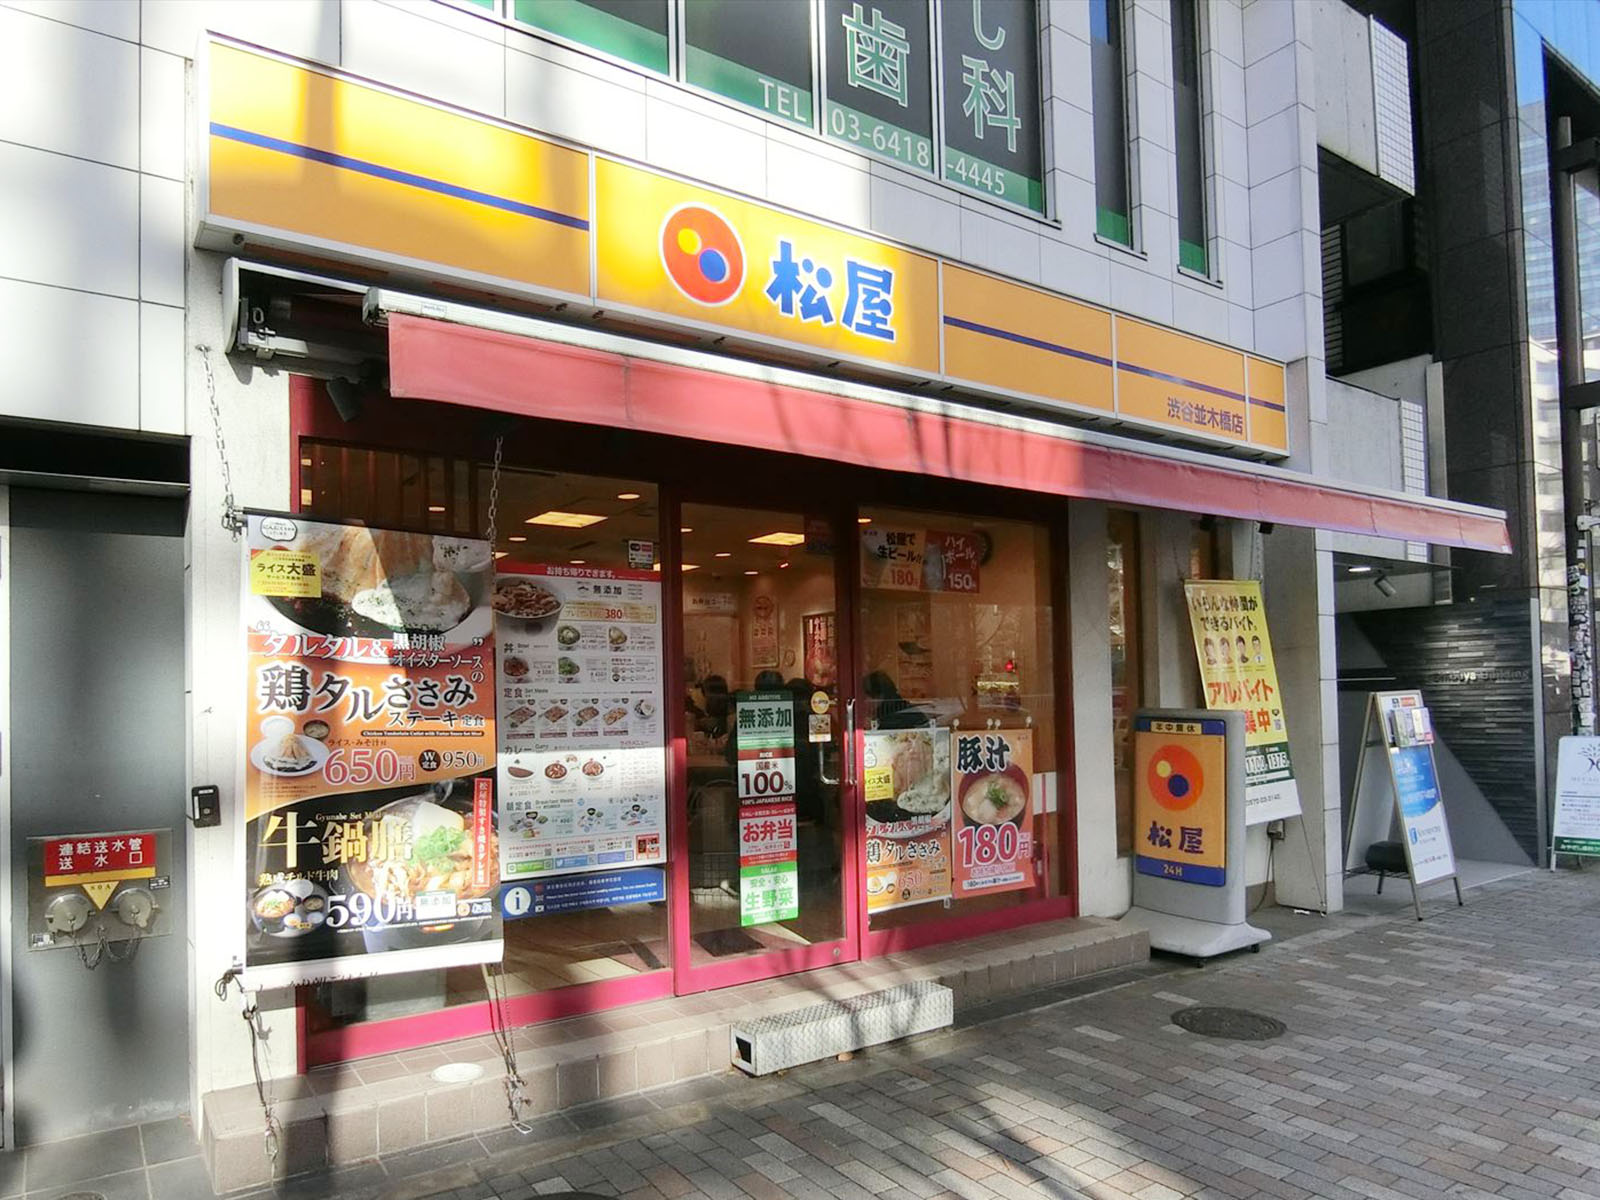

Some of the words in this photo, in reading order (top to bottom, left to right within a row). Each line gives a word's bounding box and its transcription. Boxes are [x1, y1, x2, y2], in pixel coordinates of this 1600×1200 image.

[758, 78, 807, 122] TEL
[765, 239, 895, 342] 松屋
[1167, 396, 1243, 435] 渋谷並木橋店
[257, 563, 316, 577] ライス大盛
[392, 632, 446, 651] 黒胡椒
[260, 664, 475, 722] 鶏タルささみ
[504, 687, 523, 698] 定食
[1207, 678, 1274, 707] アルバイト
[388, 711, 458, 728] ステーキ
[461, 715, 484, 727] 定食
[739, 707, 792, 729] 無添加
[504, 744, 532, 755] カレー
[957, 735, 1010, 772] 豚汁
[741, 770, 793, 795] 100%
[258, 811, 414, 870] 牛鍋膳
[743, 818, 793, 843] お弁当
[1147, 820, 1204, 855] 松屋
[58, 838, 143, 857] 連結送水管
[957, 821, 1030, 868] 180円
[1162, 863, 1183, 877] 24H
[327, 890, 414, 928] 590円
[745, 887, 794, 912] 生野菜
